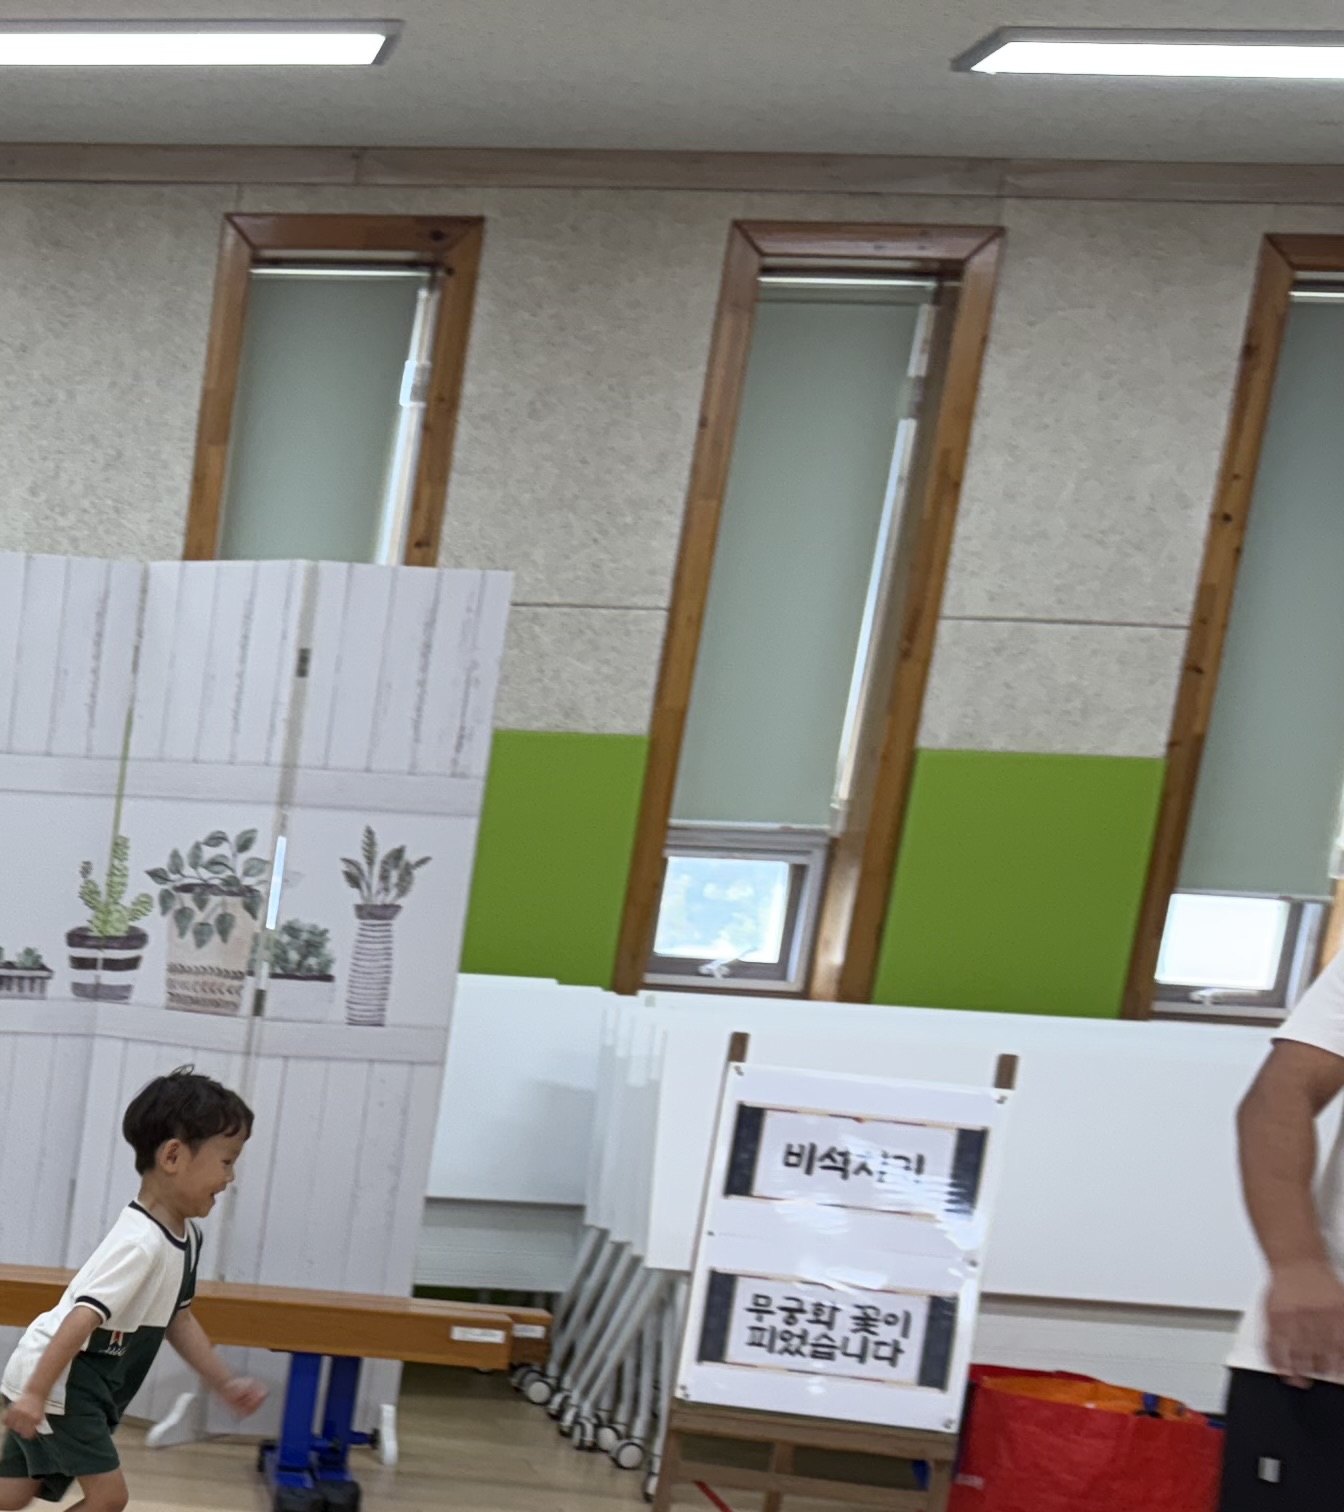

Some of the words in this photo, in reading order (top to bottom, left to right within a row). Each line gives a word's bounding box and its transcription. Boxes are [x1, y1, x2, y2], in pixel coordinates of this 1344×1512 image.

[744, 1294, 842, 1331] 무궁화
[850, 1304, 911, 1339] 꽃이
[745, 1325, 905, 1367] 피었습니다
